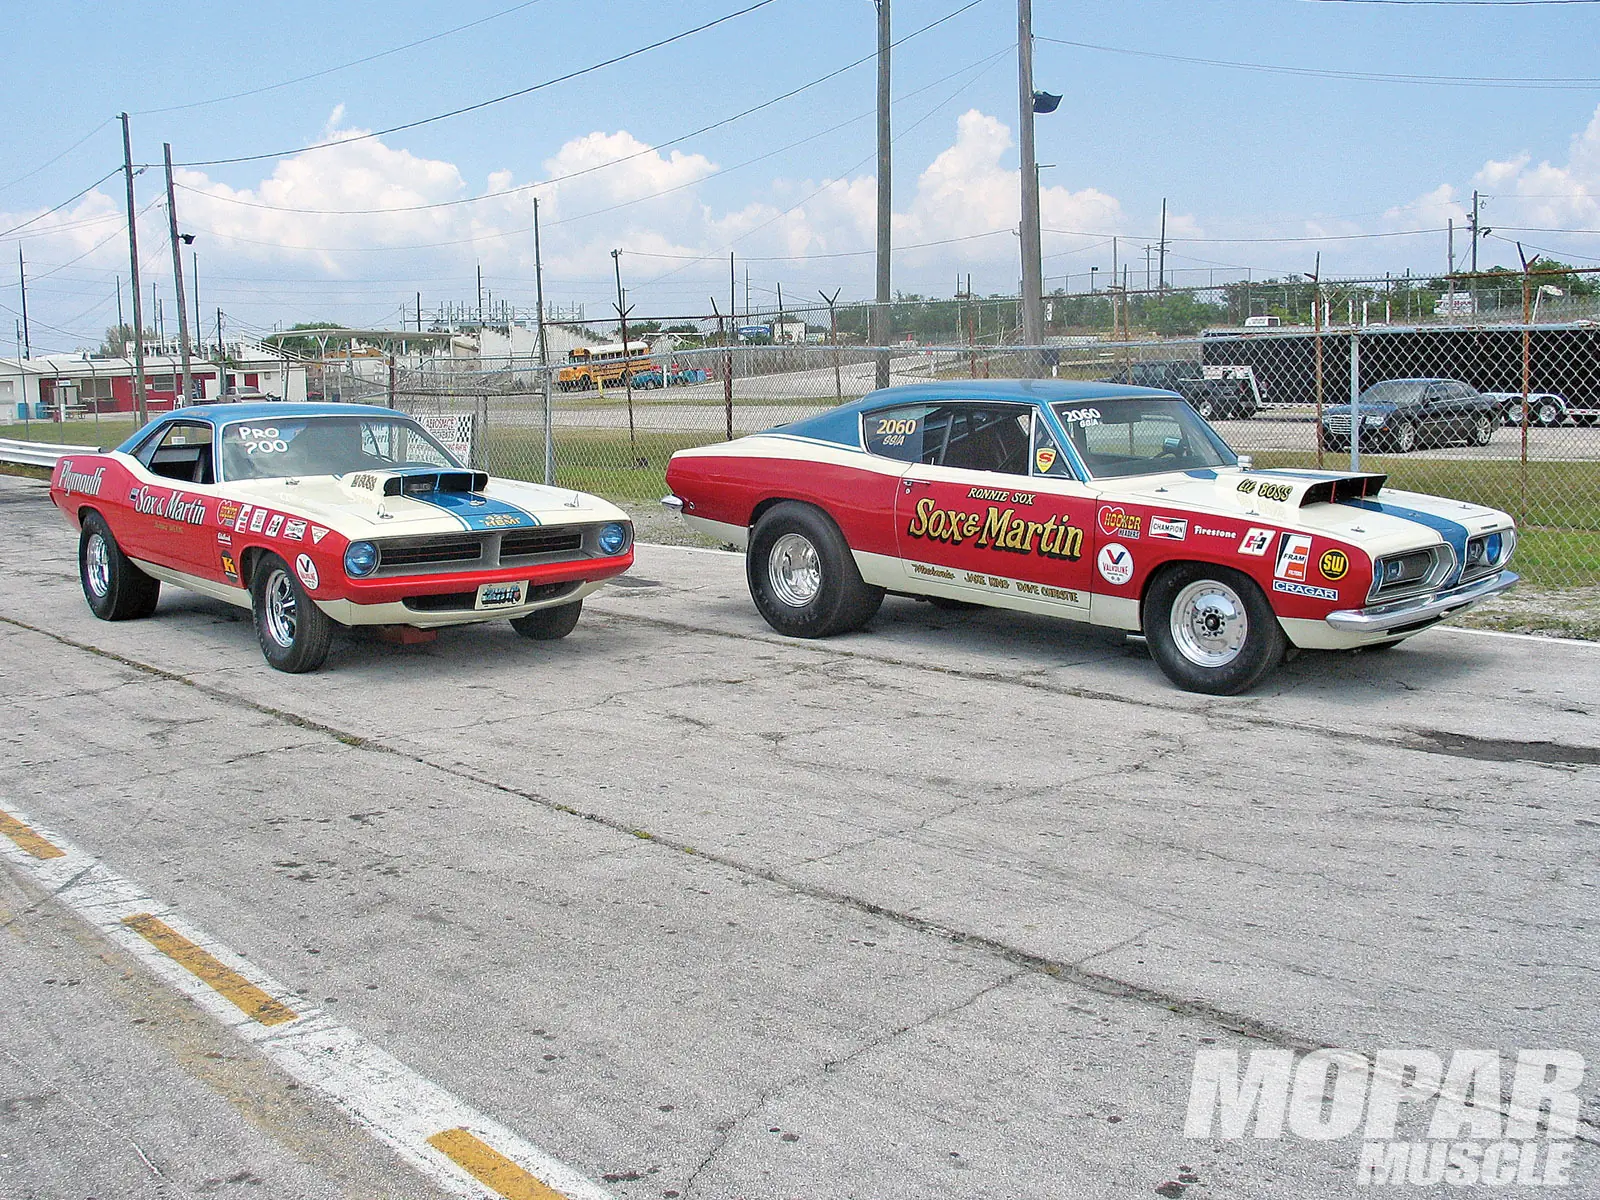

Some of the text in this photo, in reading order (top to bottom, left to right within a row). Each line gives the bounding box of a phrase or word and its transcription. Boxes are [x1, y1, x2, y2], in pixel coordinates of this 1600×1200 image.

[1062, 408, 1101, 422] 2060
[238, 426, 280, 440] PRO
[876, 419, 916, 434] 2060
[57, 460, 106, 496] Plymouth
[968, 488, 1036, 505] RONNIE SOX
[1258, 482, 1293, 502] BOSS
[135, 485, 158, 515] Sox
[156, 498, 166, 516] &
[164, 490, 206, 525] Martin
[908, 498, 965, 542] Sox
[976, 507, 1084, 560] Martin
[1104, 512, 1142, 531] HOOKER
[1153, 523, 1184, 534] CHAMPION
[1119, 529, 1139, 539] HEADERS
[1193, 525, 1237, 539] Firestone
[1283, 553, 1305, 562] FRAM
[1323, 554, 1344, 572] SW
[1103, 562, 1129, 576] VALVOLINE
[1275, 582, 1335, 600] CRAGAR
